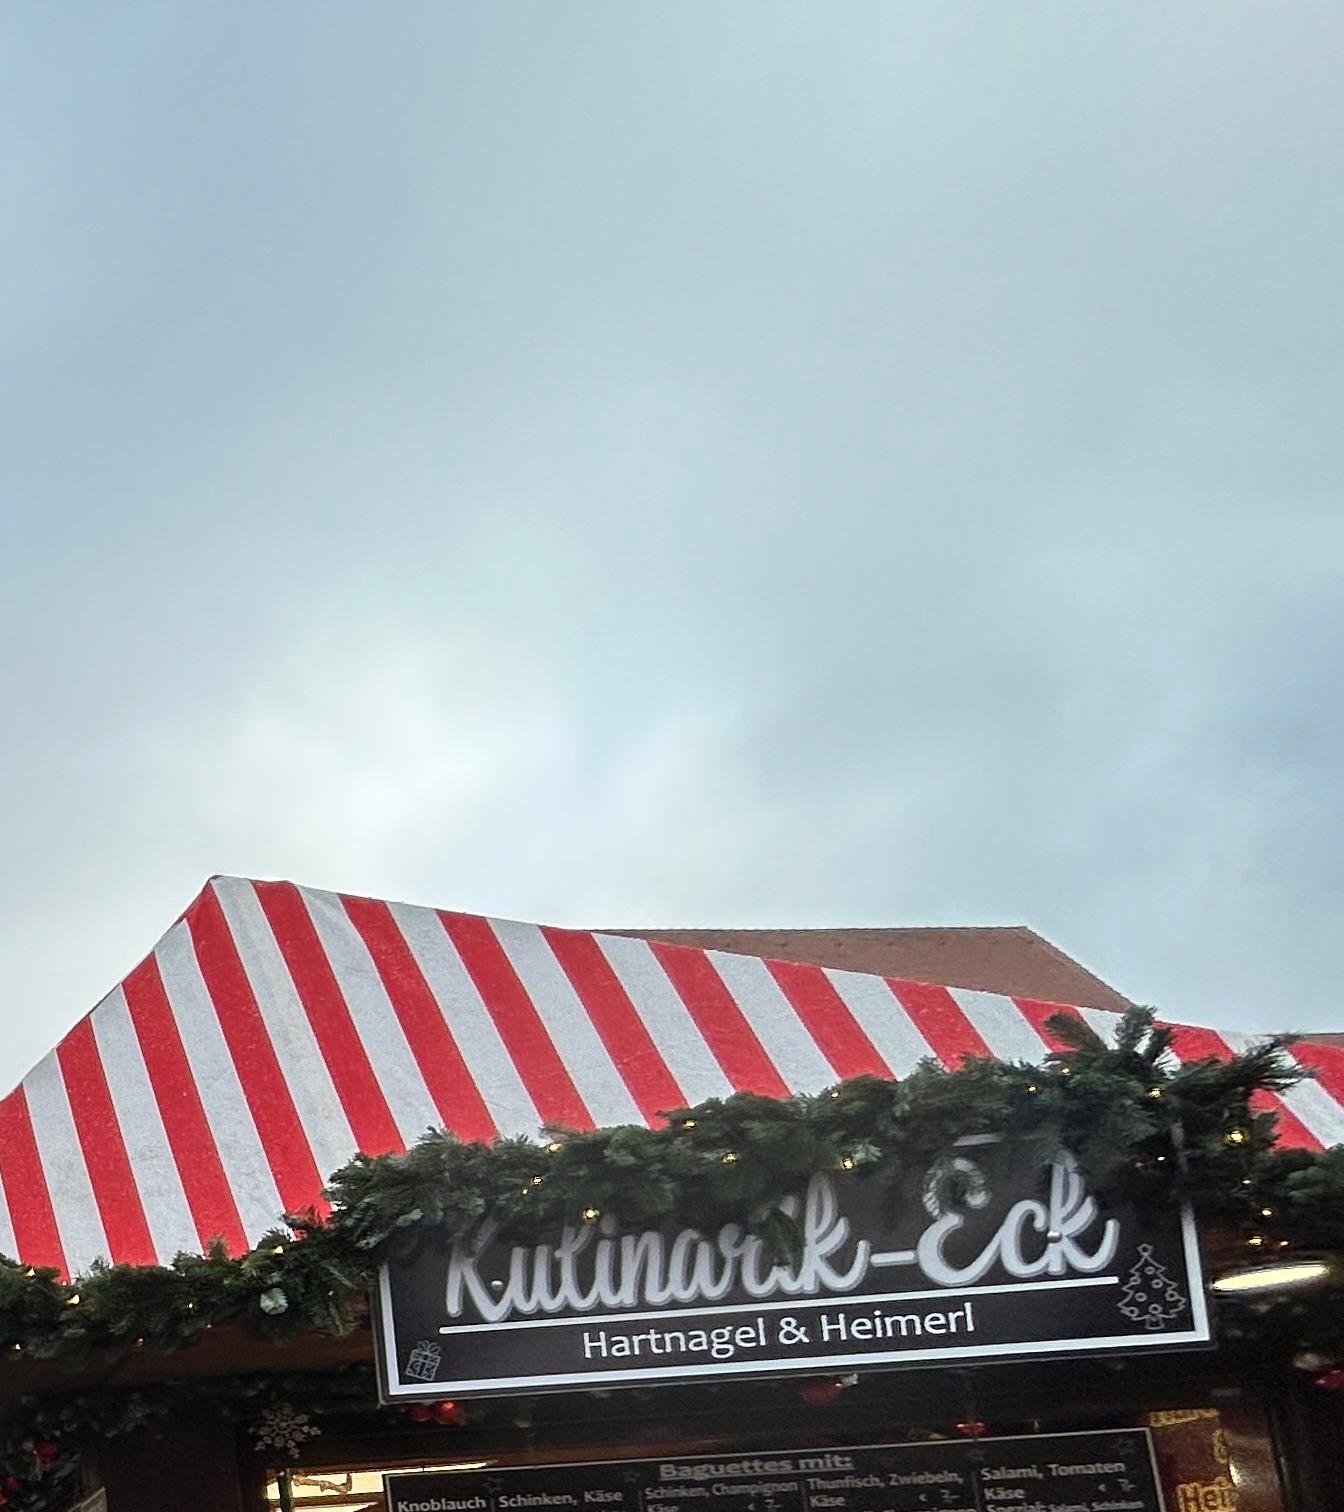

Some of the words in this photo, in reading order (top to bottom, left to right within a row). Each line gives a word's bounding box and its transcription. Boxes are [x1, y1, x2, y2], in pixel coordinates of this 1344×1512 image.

[582, 1317, 766, 1359] Hartnagel
[779, 1316, 810, 1345] &
[821, 1301, 975, 1342] Heimerl
[660, 1457, 793, 1480] Baguettes
[799, 1453, 853, 1470] mit:
[980, 1463, 1043, 1481] Salami,
[1048, 1461, 1125, 1476] Tomaten
[889, 1471, 964, 1486] Zwiebeln,
[498, 1493, 578, 1509] Schinken,
[584, 1489, 623, 1503] Käse
[645, 1485, 710, 1499] Schinken,
[712, 1480, 798, 1497] Champignon
[984, 1486, 1025, 1500] Käse
[398, 1497, 487, 1512] Knoblauch
[810, 1494, 846, 1507] Käse
